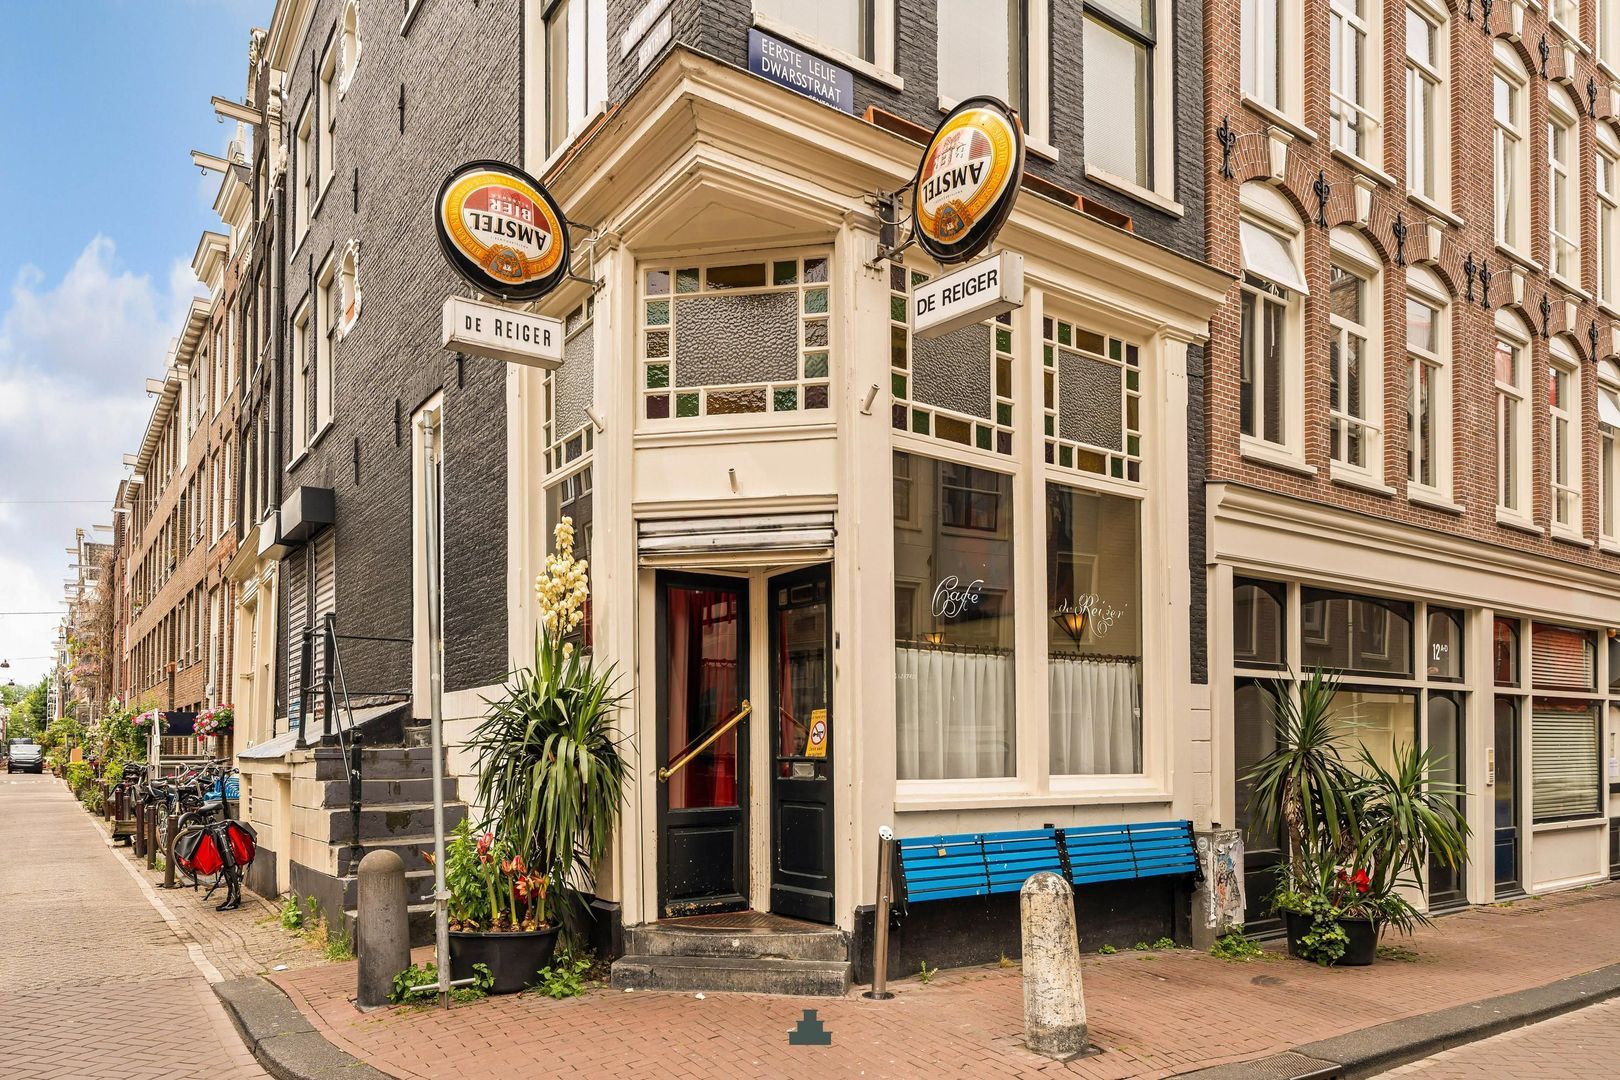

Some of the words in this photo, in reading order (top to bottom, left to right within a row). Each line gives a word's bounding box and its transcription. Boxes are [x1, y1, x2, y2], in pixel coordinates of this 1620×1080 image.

[761, 38, 802, 68] EERSTE
[809, 59, 836, 83] LELIE
[761, 57, 842, 103] DWARSSTRAAT
[923, 161, 985, 204] AMSTEL
[470, 212, 547, 251] AMSTEL
[489, 198, 532, 222] BIER
[917, 294, 937, 317] DE
[942, 269, 998, 307] REIGER
[465, 315, 481, 332] DE
[495, 319, 551, 347] REIGER
[932, 575, 984, 618] Café
